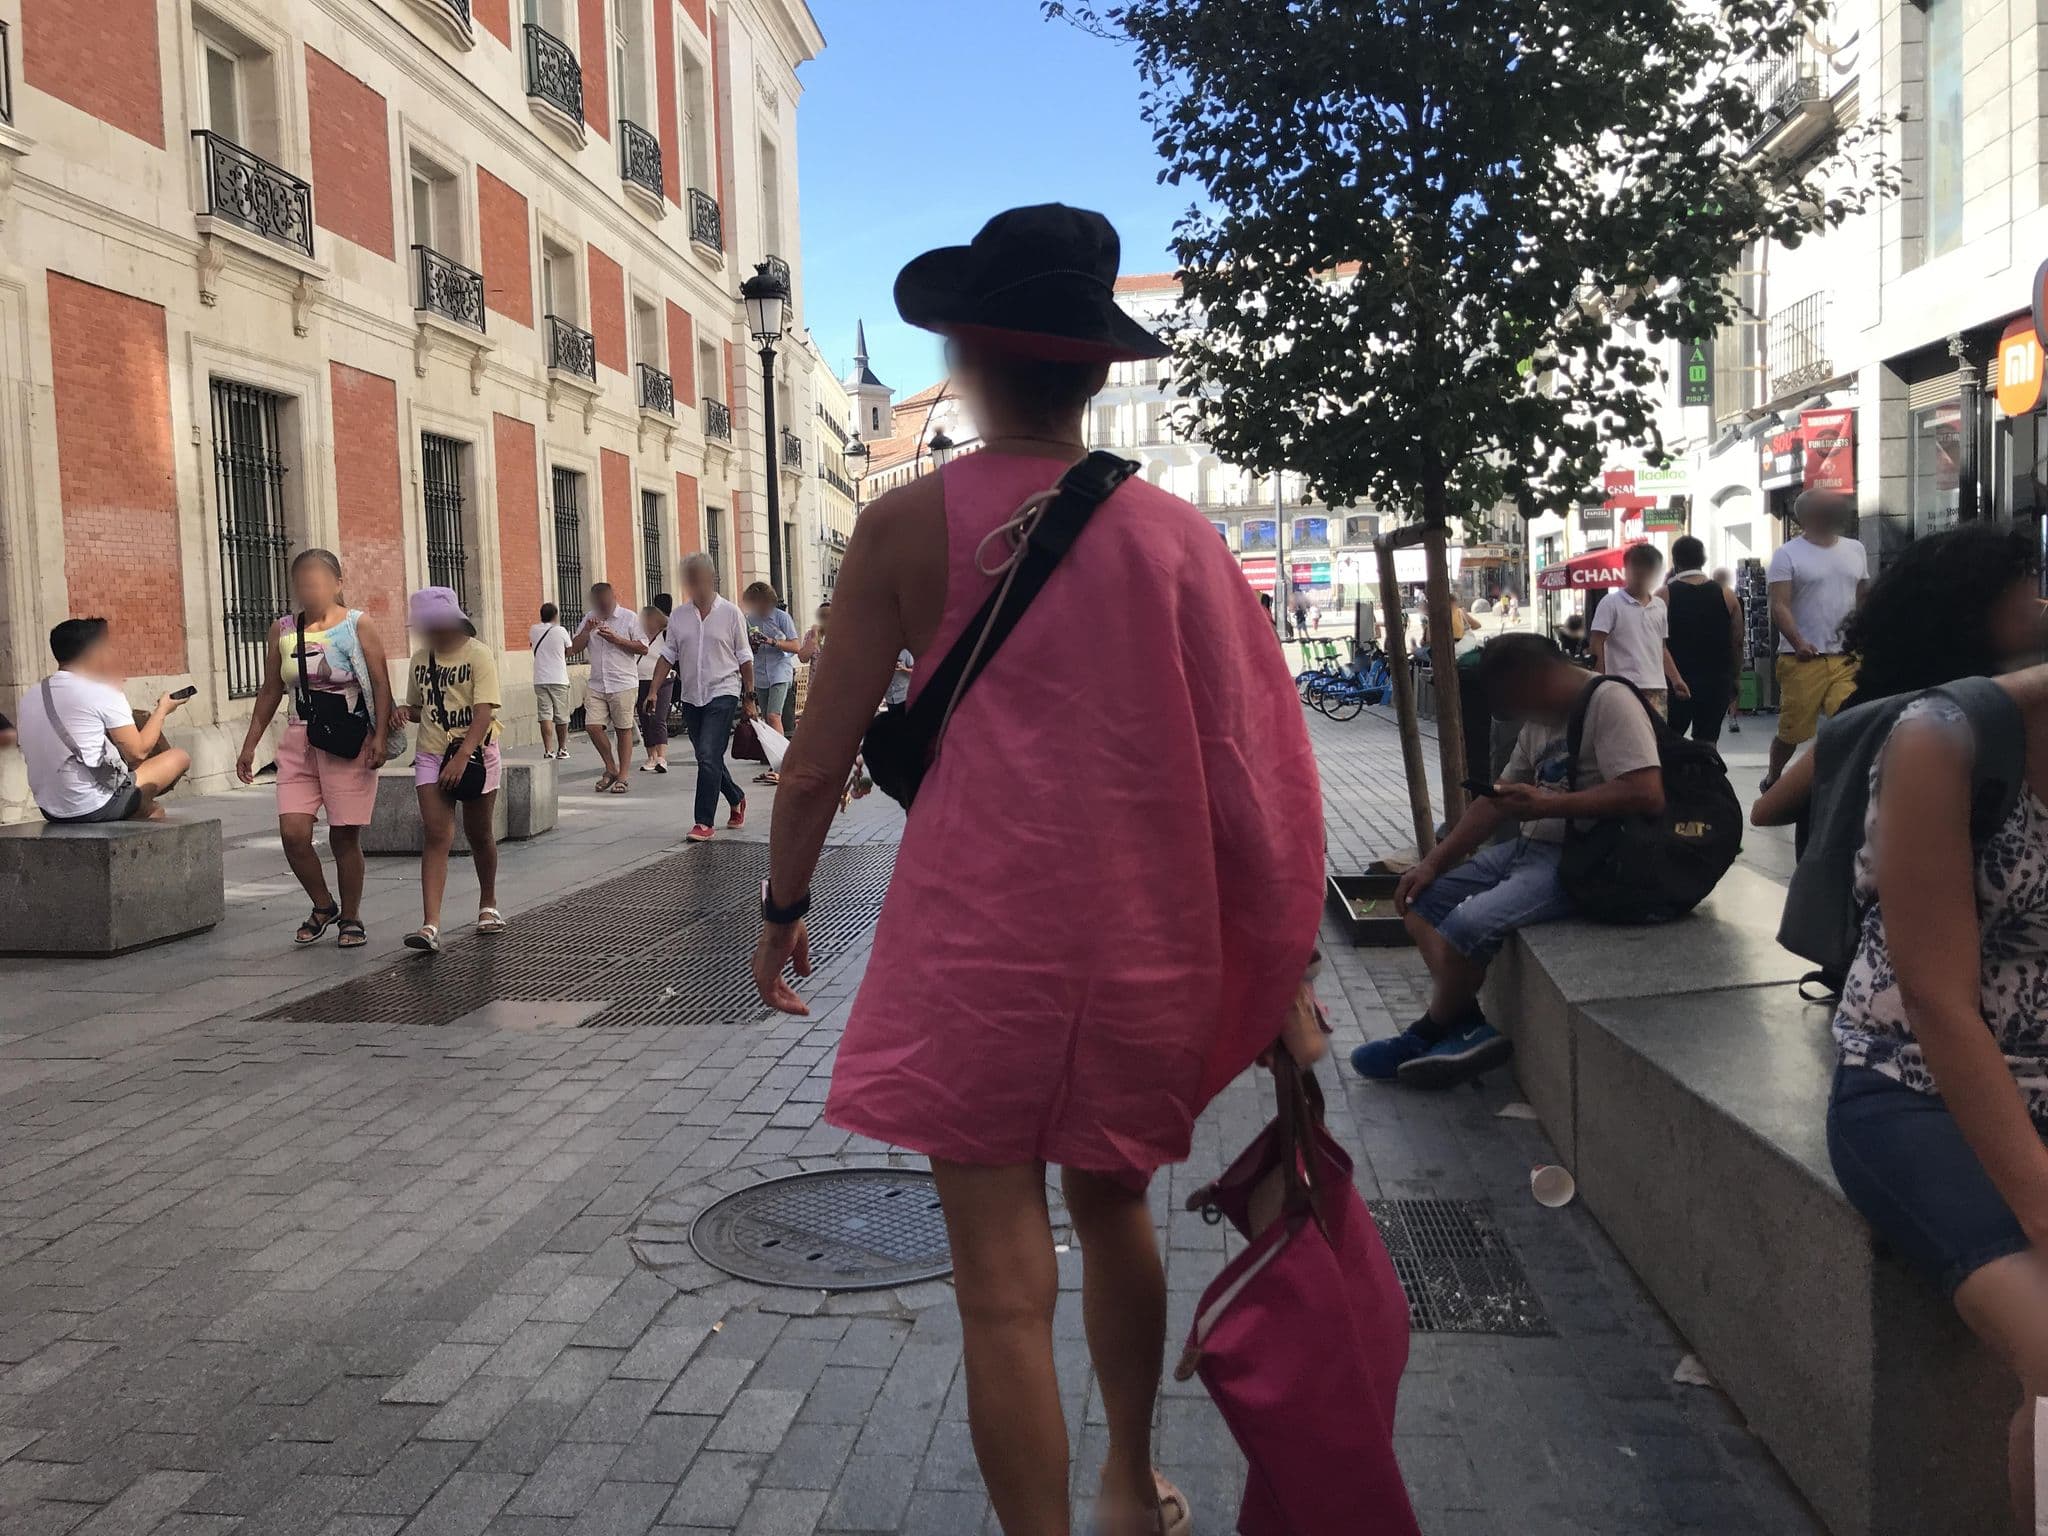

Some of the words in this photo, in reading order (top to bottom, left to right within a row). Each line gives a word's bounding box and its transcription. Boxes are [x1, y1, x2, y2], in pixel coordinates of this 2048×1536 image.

[415, 665, 457, 686] GROING
[449, 705, 473, 728] BAD
[1675, 821, 1705, 838] CAT
